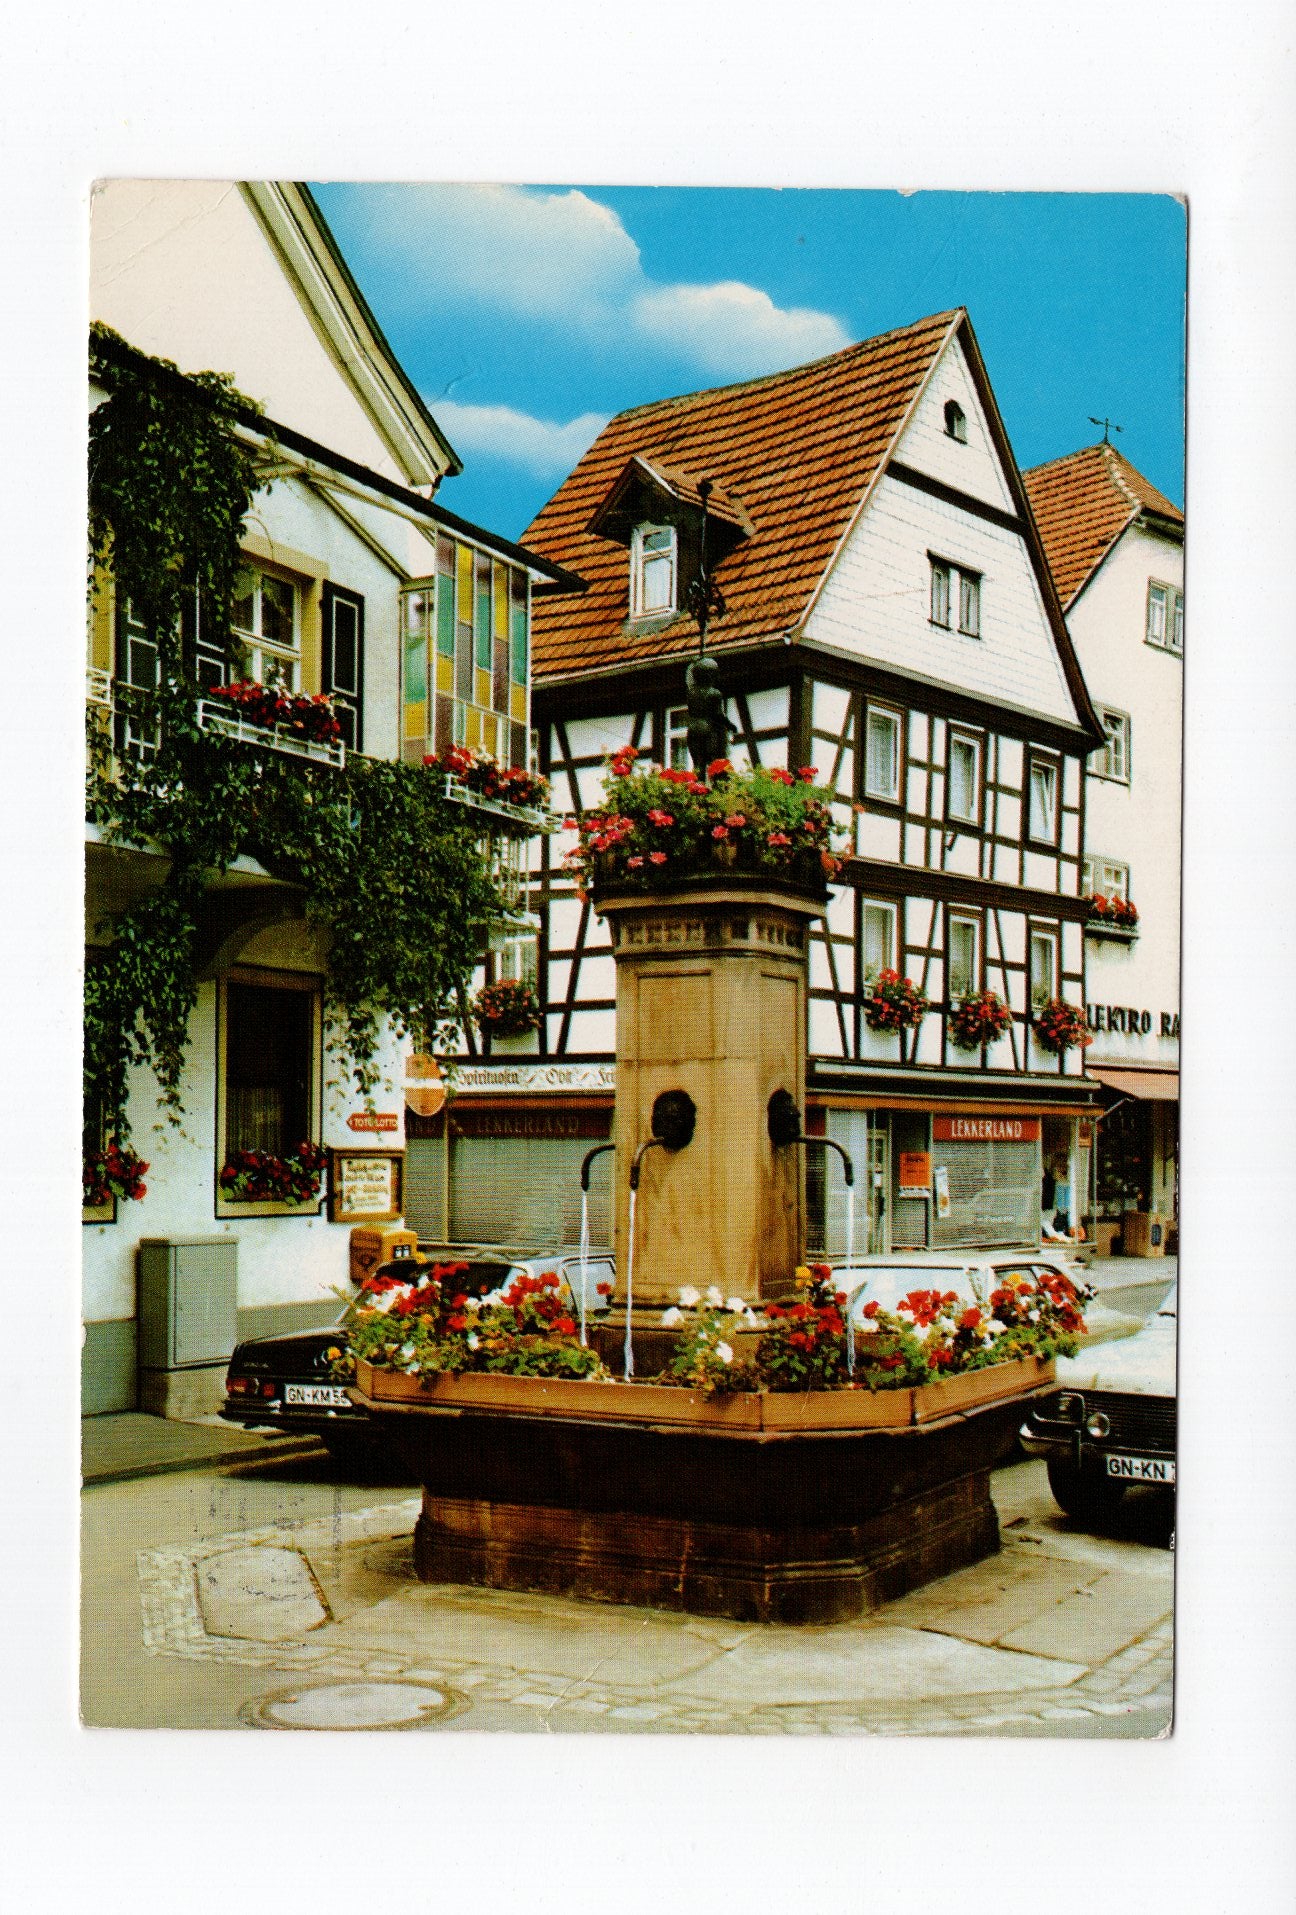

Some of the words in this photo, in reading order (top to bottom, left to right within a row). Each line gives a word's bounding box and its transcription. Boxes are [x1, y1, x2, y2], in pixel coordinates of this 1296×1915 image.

[1086, 1003, 1151, 1034] LEKTRO
[951, 1119, 1022, 1138] LEKKERLAND
[1109, 1458, 1165, 1478] GN-KN
